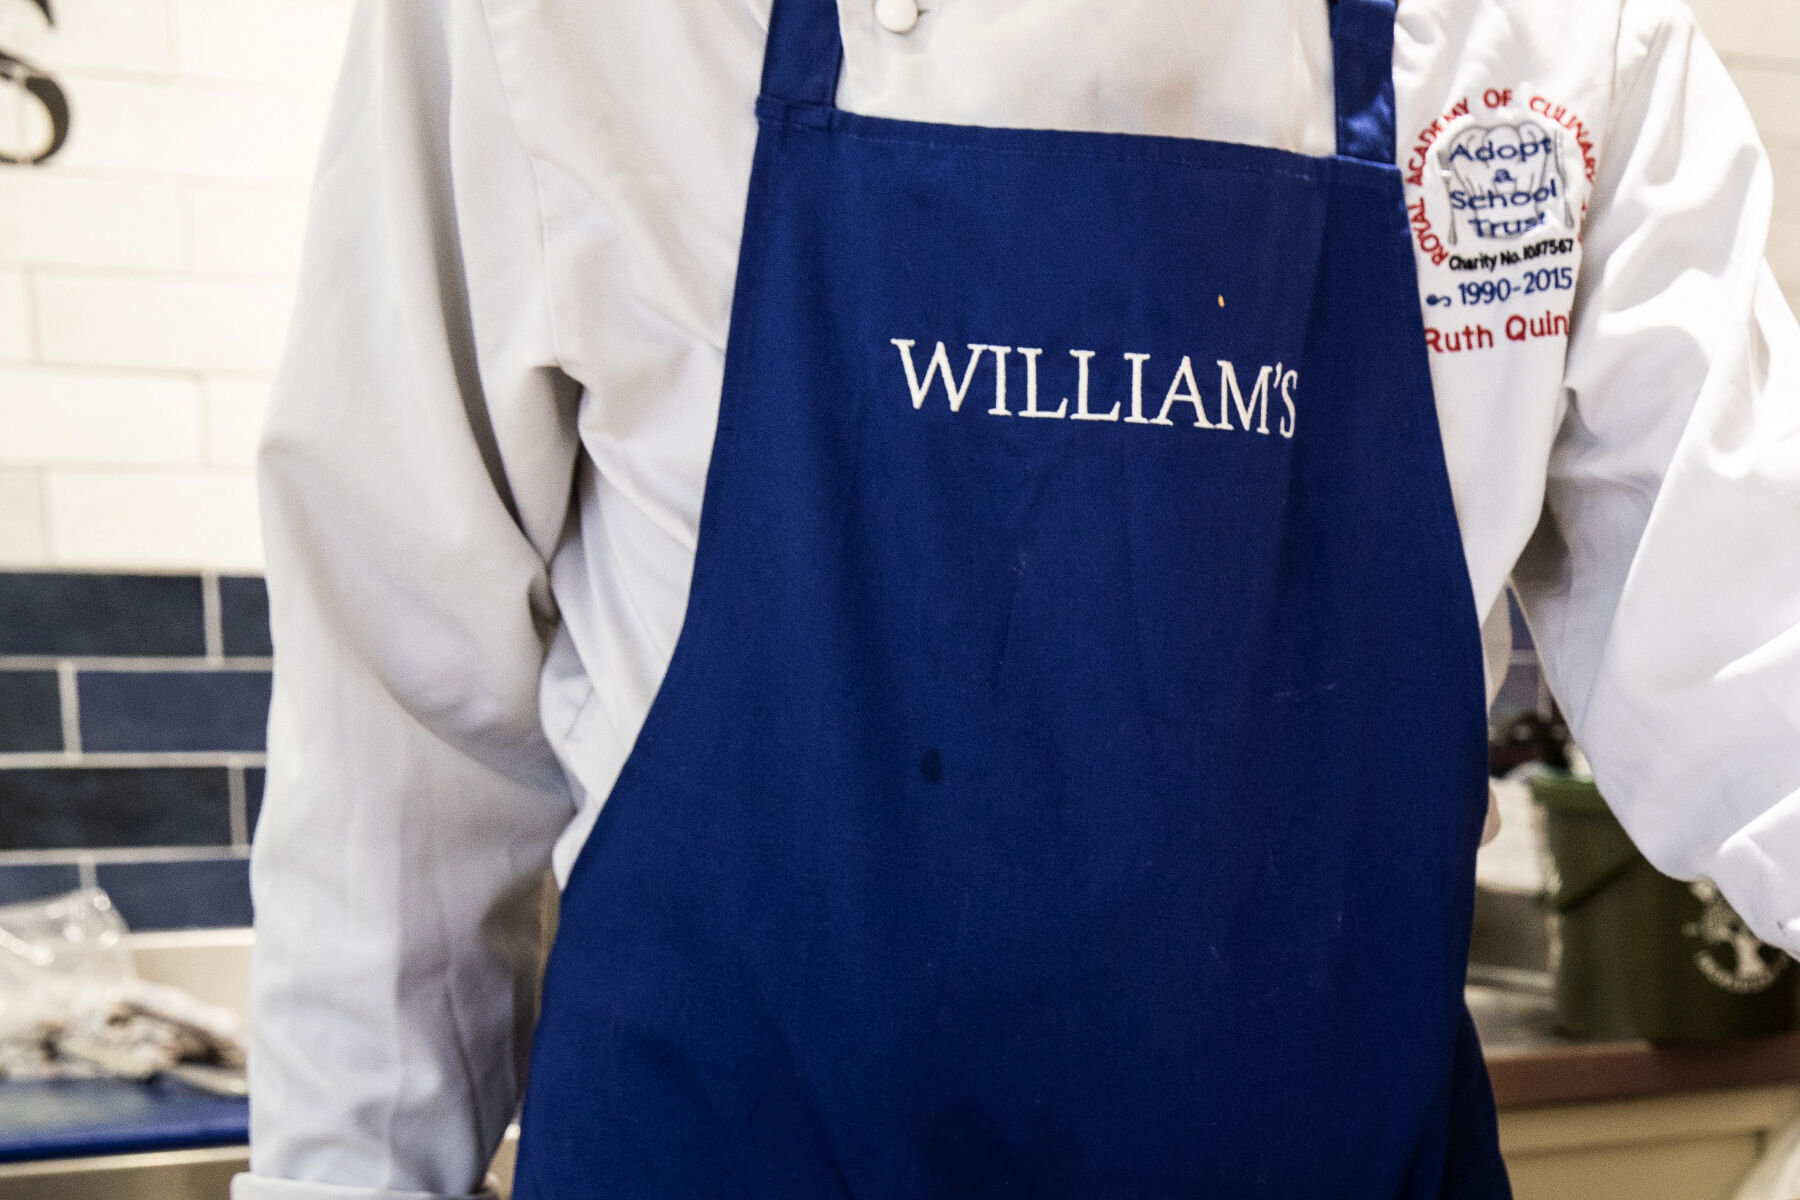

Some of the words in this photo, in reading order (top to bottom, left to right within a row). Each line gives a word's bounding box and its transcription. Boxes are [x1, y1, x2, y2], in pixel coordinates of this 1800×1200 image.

[1449, 137, 1556, 162] Adopt
[1406, 197, 1449, 266] ROYAL
[1483, 89, 1513, 109] OF
[1529, 95, 1597, 184] CULINARY
[1494, 168, 1516, 183] a
[1450, 179, 1557, 211] School
[1449, 252, 1497, 272] Charity
[1500, 248, 1521, 266] No.
[1457, 267, 1573, 305] 1990-2015
[1425, 324, 1494, 353] Ruth
[1505, 310, 1571, 341] Quin
[890, 338, 1298, 438] WILLIAM'S
